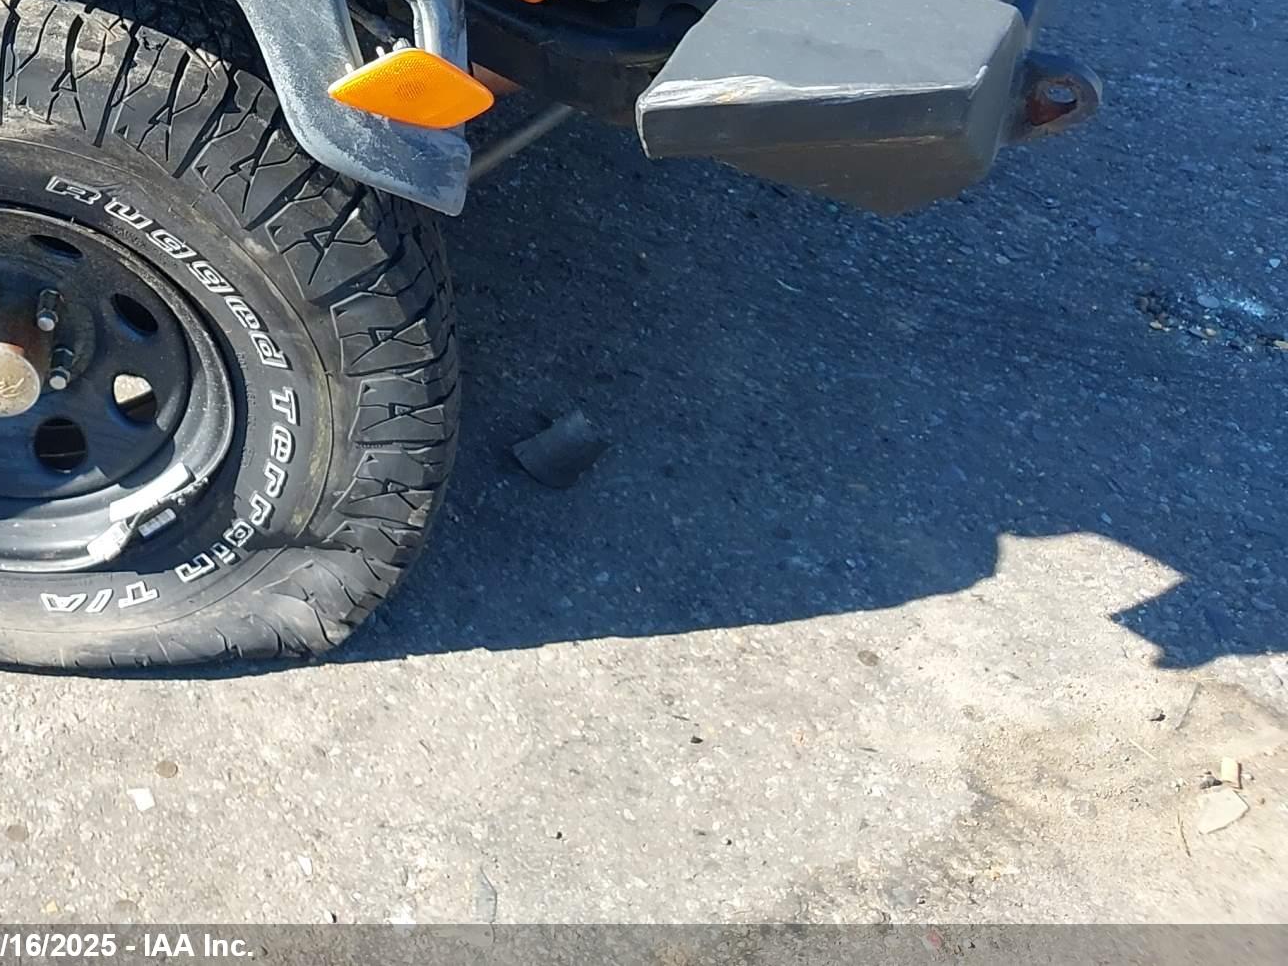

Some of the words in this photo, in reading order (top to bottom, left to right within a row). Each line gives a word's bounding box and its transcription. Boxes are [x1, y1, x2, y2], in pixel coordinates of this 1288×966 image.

[44, 174, 290, 369] Rugged
[174, 386, 300, 583] Terrain
[39, 580, 160, 614] T/A
